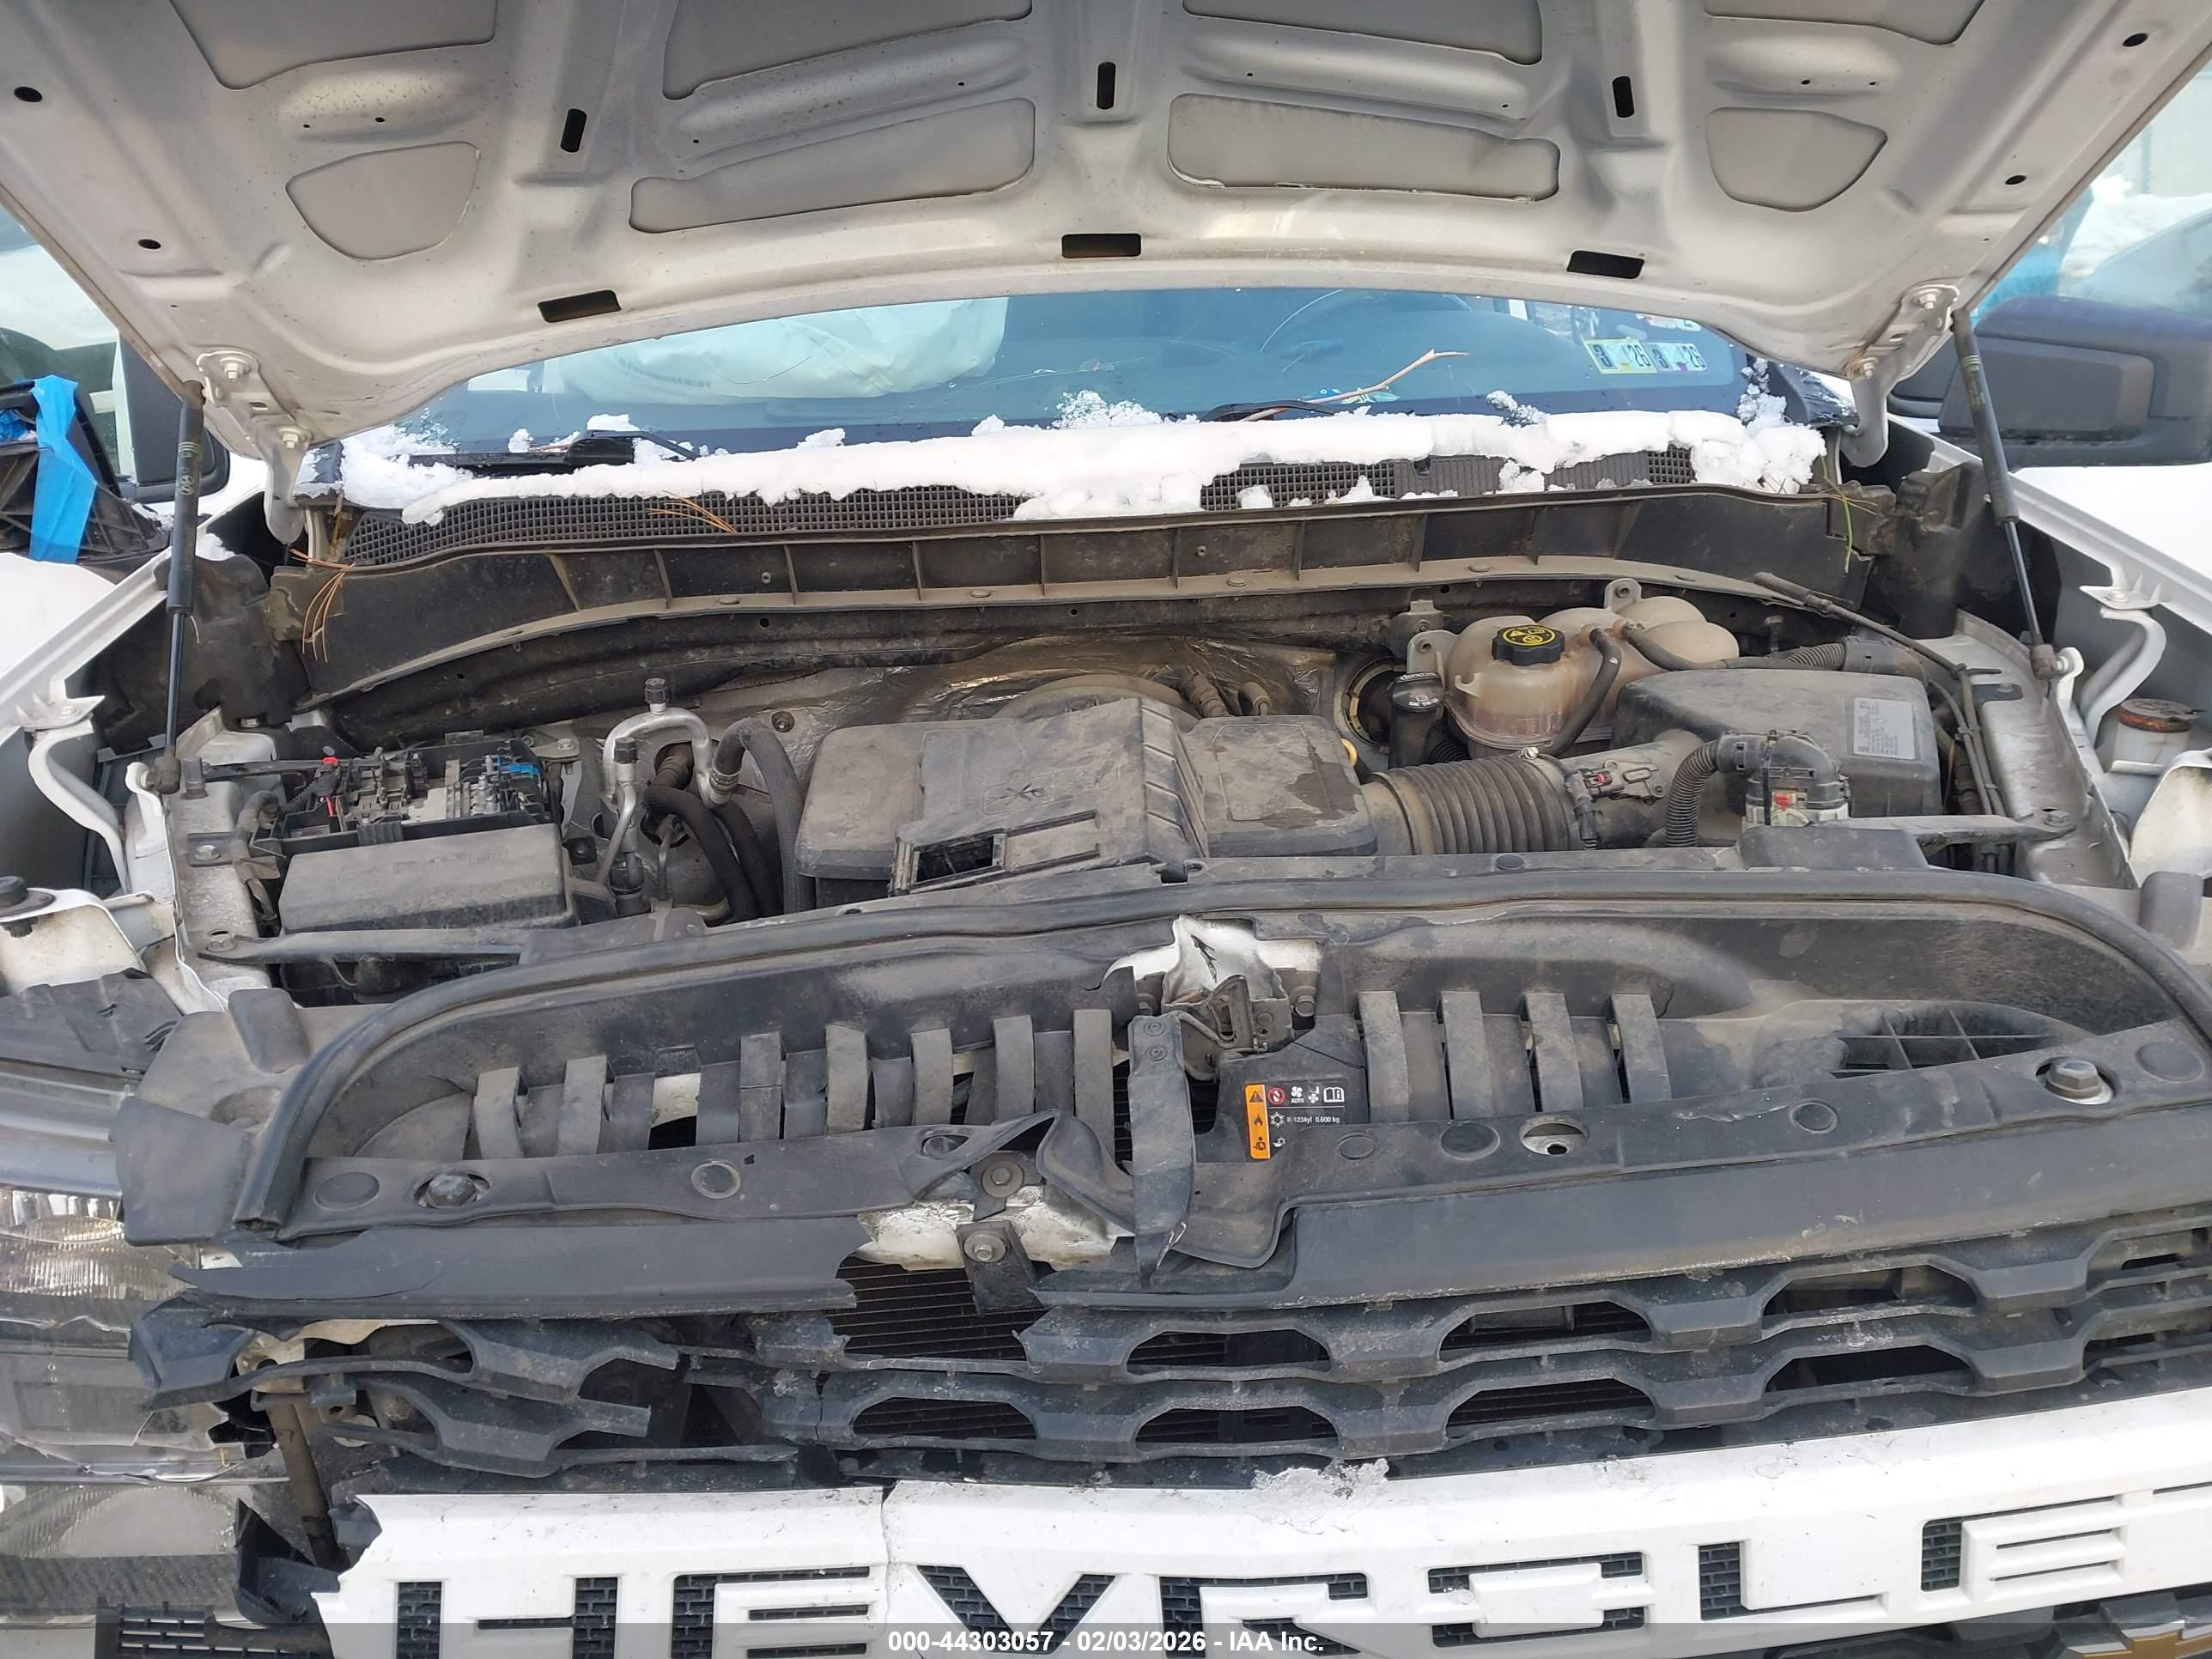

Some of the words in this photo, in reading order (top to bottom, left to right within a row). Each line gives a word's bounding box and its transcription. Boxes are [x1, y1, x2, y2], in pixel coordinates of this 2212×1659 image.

[1592, 343, 1613, 368] 3
[1627, 344, 1651, 368] 26
[1652, 349, 1669, 369] 3
[1683, 345, 1706, 368] 26
[1332, 1115, 1340, 1124] kg
